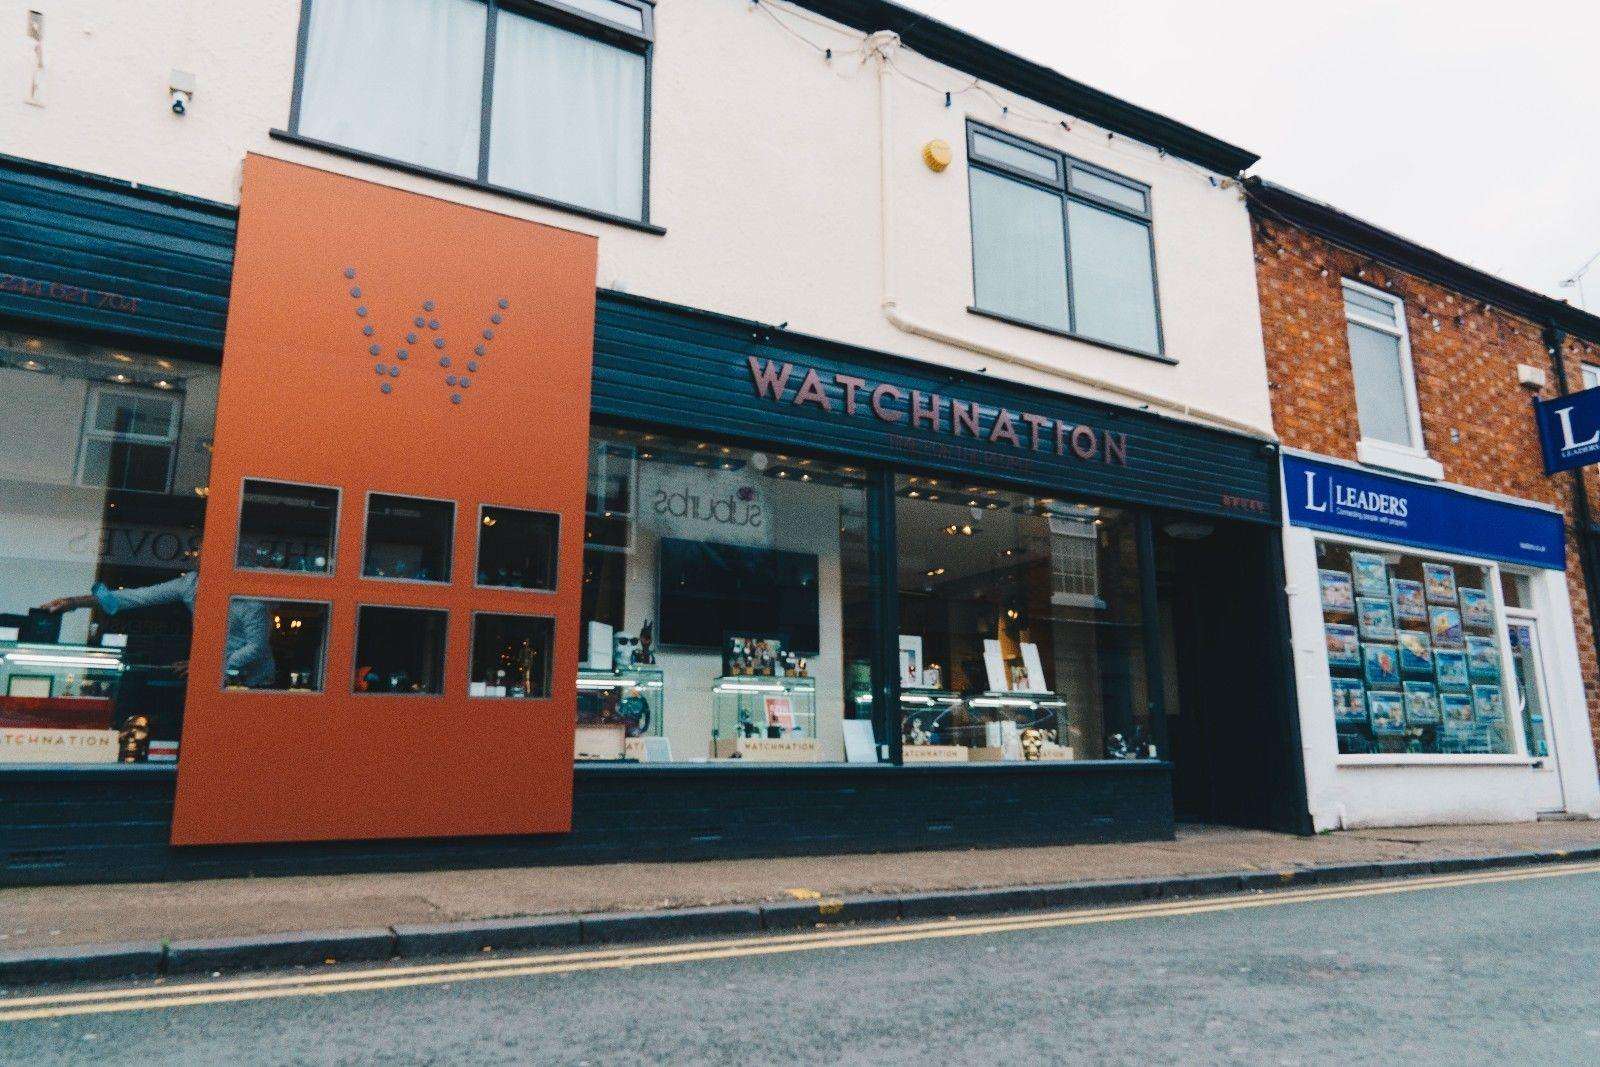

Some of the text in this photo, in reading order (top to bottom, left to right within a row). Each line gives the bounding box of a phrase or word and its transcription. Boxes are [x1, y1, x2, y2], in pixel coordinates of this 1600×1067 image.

[749, 356, 1127, 466] WATCHNATION
[1554, 406, 1600, 452] L
[1303, 470, 1327, 513] L
[1335, 484, 1408, 518] LEADERS
[3, 734, 110, 746] TCHNATION
